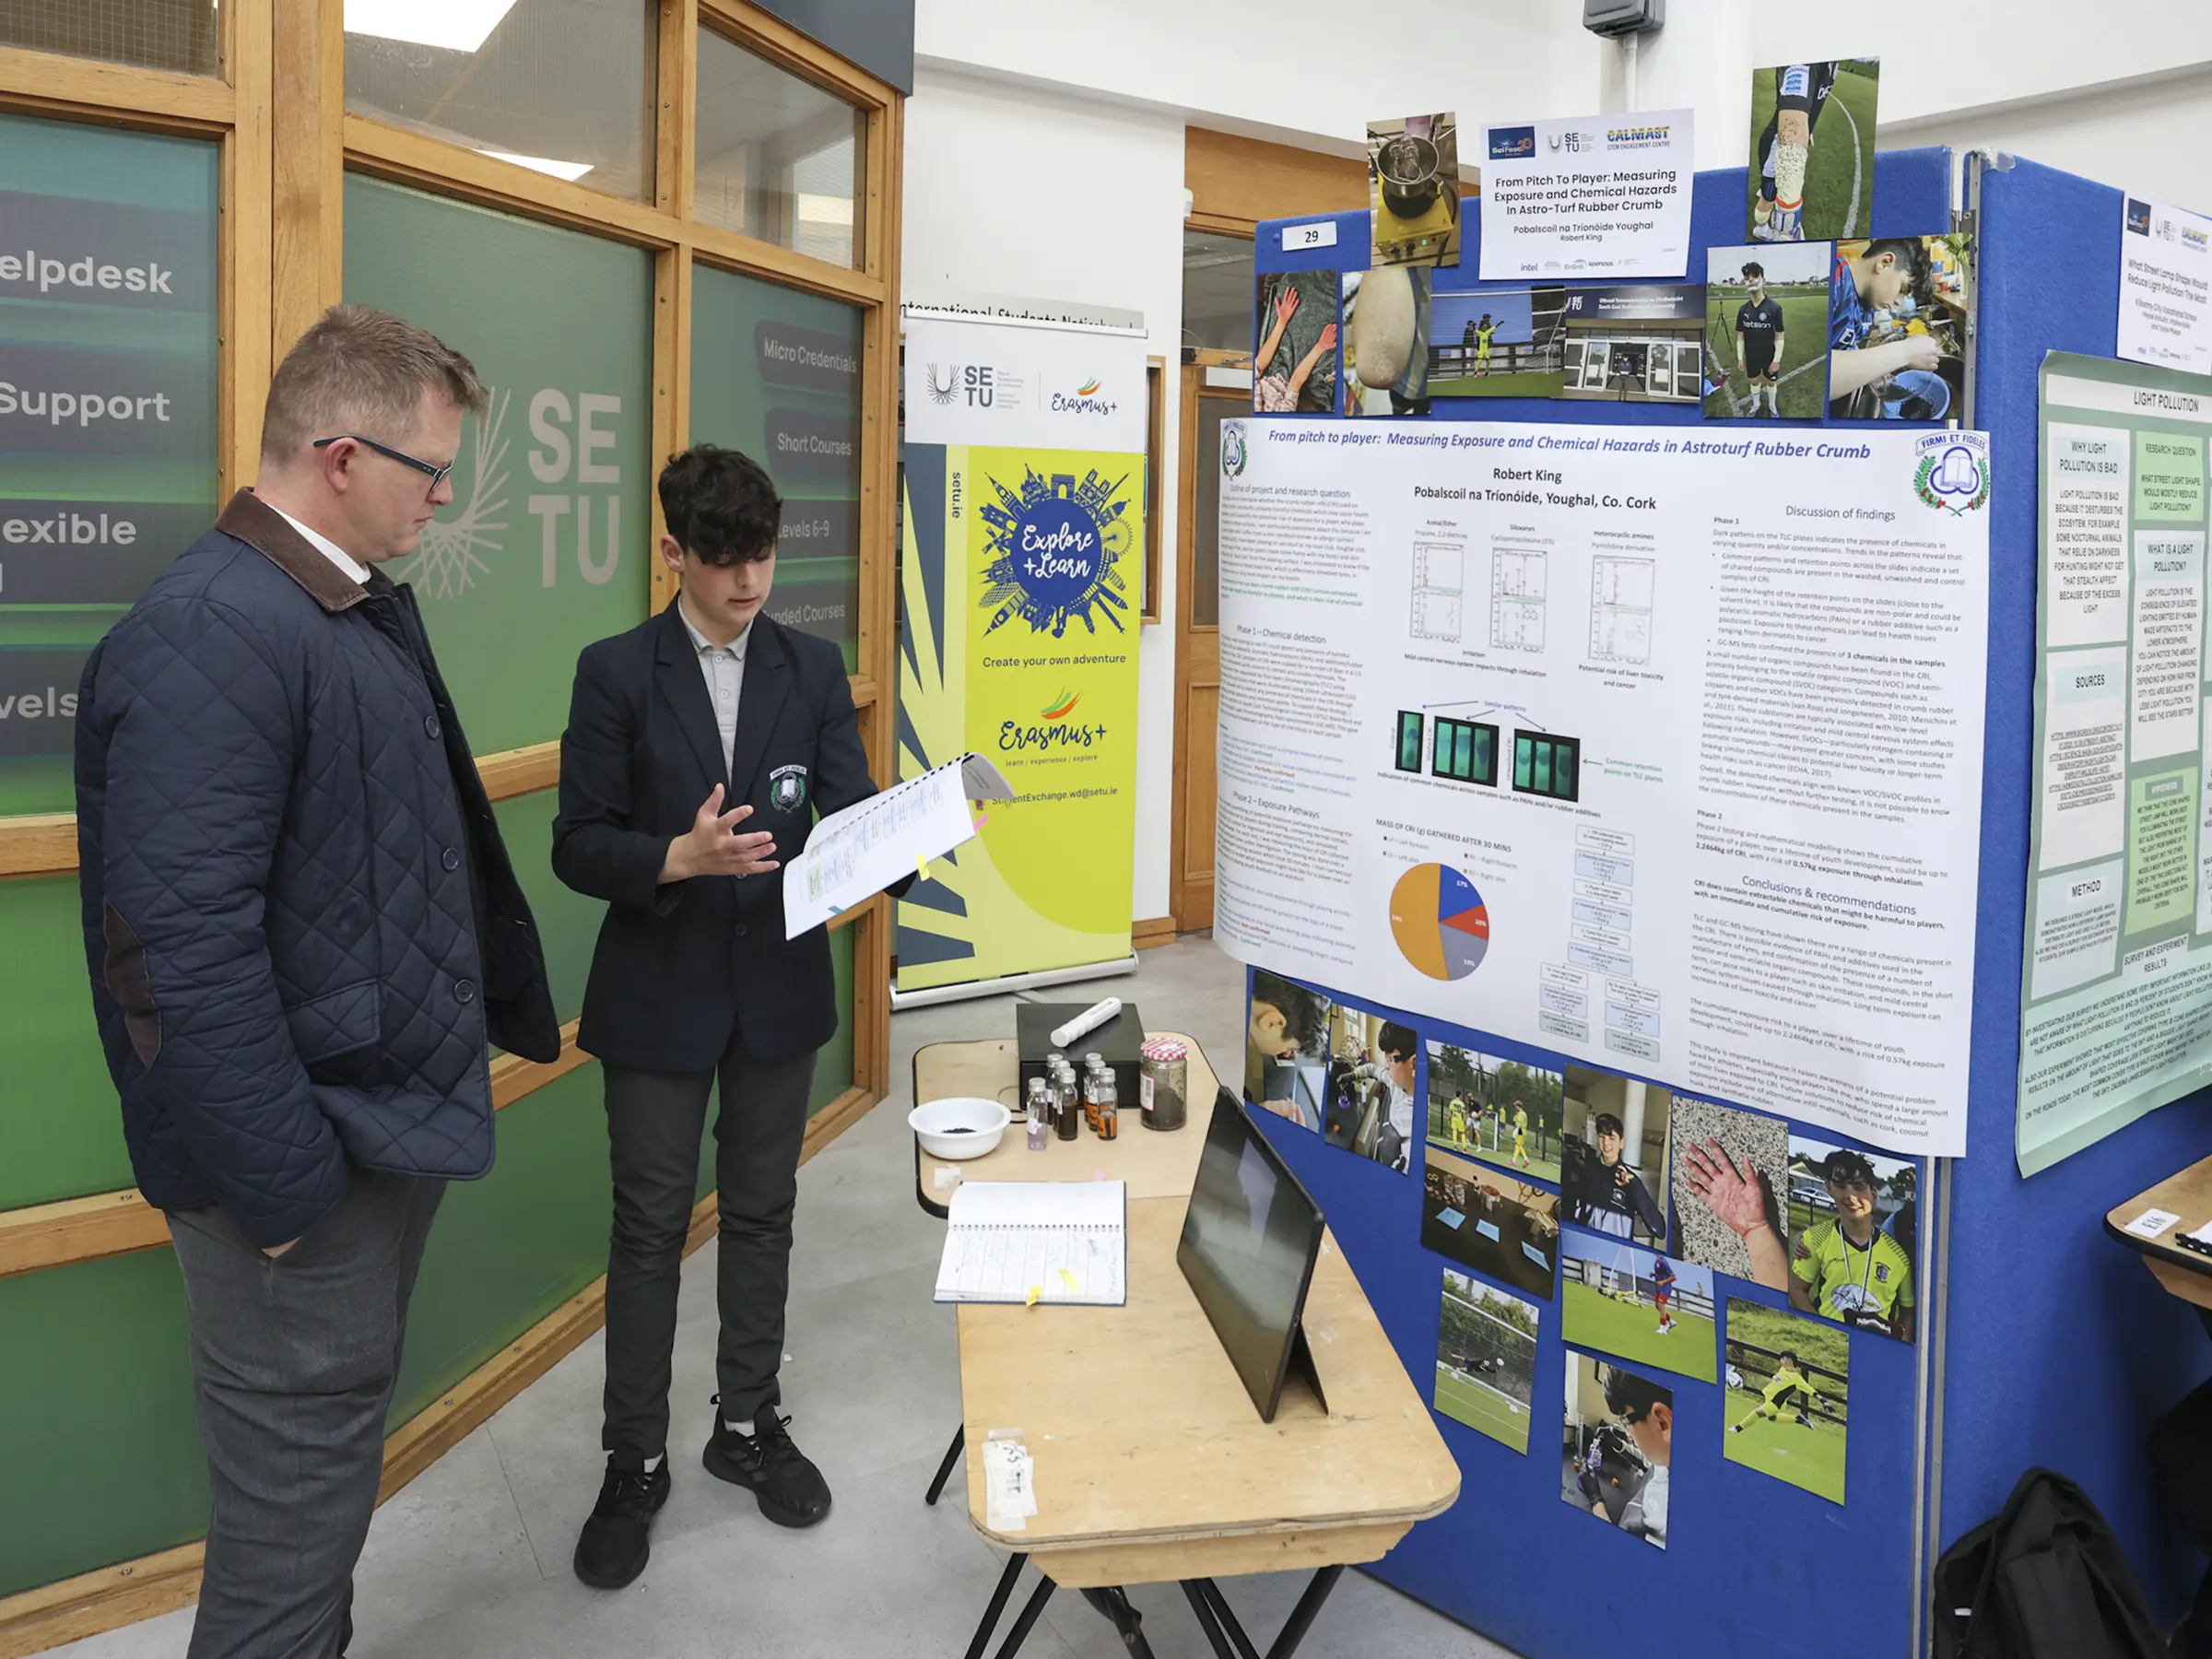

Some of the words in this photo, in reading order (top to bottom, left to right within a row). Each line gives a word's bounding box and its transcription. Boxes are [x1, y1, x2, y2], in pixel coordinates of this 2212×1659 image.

[1565, 133, 1579, 142] SE
[1607, 127, 1670, 142] CALMAST
[1565, 143, 1579, 152] TU
[1620, 142, 1653, 150] ENGAGEMENT
[1496, 178, 1524, 188] From
[1526, 175, 1553, 186] Pitch
[1556, 175, 1570, 185] To
[1572, 173, 1610, 186] Player:
[1613, 170, 1677, 182] Measuring
[1494, 191, 1544, 204] Exposure
[1547, 189, 1568, 200] and
[1571, 186, 1626, 199] Chemical
[1629, 184, 1677, 196] Hazards
[1506, 206, 1517, 216] In
[1519, 203, 1576, 216] Astro-Turf
[1578, 201, 1618, 212] Rubber
[1621, 200, 1663, 212] Crumb
[1305, 229, 1319, 243] 29
[1513, 224, 1558, 235] Pobalscoil
[1616, 221, 1653, 232] Youghal
[1586, 234, 1603, 243] King
[0, 250, 173, 294] elpdesk
[1521, 263, 1538, 272] intel
[764, 337, 796, 362] Micro
[798, 347, 857, 373] Credentials
[964, 365, 993, 386] SE
[0, 382, 171, 427] Support
[965, 387, 993, 407] TU
[1052, 393, 1118, 415] Erasmus+
[2135, 391, 2157, 407] LIGHT
[2159, 394, 2199, 413] POLLUTION
[527, 388, 621, 483] SE
[778, 432, 808, 453] Short
[810, 436, 852, 455] Courses
[1269, 430, 1296, 442] From
[1299, 431, 1325, 444] pitch
[1328, 433, 1339, 442] to
[1342, 432, 1381, 446] player:
[1387, 433, 1448, 449] Measuring
[1451, 434, 1505, 450] Exposure
[1509, 436, 1533, 449] and
[1537, 436, 1600, 450] Chemical
[1603, 439, 1660, 453] Hazards
[1664, 440, 1677, 453] in
[1681, 441, 1752, 457] Astroturf
[1754, 442, 1812, 457] Rubber
[1816, 443, 1871, 459] Crumb
[1922, 435, 1947, 450] FIRMI
[1950, 434, 1959, 442] ET
[1962, 434, 1985, 451] FIDELES
[2071, 441, 2087, 453] WHY
[2088, 442, 2107, 454] LIGHT
[2146, 443, 2171, 454] RESEARCH
[2171, 445, 2196, 457] QUESTION
[2060, 459, 2096, 473] POLLUTION
[2097, 463, 2103, 472] IS
[2104, 462, 2118, 474] BAD
[1493, 468, 1532, 481] Robert
[1535, 469, 1562, 484] King
[952, 472, 963, 519] setu.ie
[1414, 486, 1466, 500] Pobalscoil
[1469, 490, 1482, 500] na
[1485, 488, 1543, 505] Tríonóide,
[1547, 492, 1599, 508] Youghal,
[1602, 495, 1622, 508] Co.
[1627, 496, 1656, 509] Cork
[1786, 505, 1840, 519] Discussion
[1842, 510, 1854, 519] of
[1855, 509, 1896, 522] findings
[3, 512, 136, 545] exible
[813, 520, 830, 537] 6-9
[1021, 522, 1094, 553] Explore
[527, 495, 620, 588] TU
[1023, 552, 1091, 579] +Learn
[804, 604, 845, 624] Courses
[982, 657, 1020, 667] Create
[1023, 658, 1046, 668] your
[1049, 656, 1070, 665] own
[1073, 654, 1126, 665] adventure
[1900, 656, 1912, 665] the
[2076, 674, 2105, 688] SOURCES
[999, 721, 1107, 750] Erasmus+
[1030, 756, 1066, 766] experience
[1073, 754, 1098, 763] explore
[992, 787, 1118, 805] StentExchange.wd@setu.ie
[1376, 819, 1394, 830] MASS
[1405, 824, 1416, 833] CRI
[1417, 827, 1425, 836] (g)
[1427, 829, 1460, 842] GATHERED
[1462, 835, 1482, 846] AFTER
[1483, 840, 1493, 848] 30
[1493, 841, 1512, 853] MINS
[1818, 865, 1851, 877] exposure
[1853, 870, 1882, 882] through
[1742, 876, 1803, 898] Conclusions
[1805, 888, 1814, 899] &
[1816, 890, 1916, 915] recommendations
[2072, 879, 2101, 897] METHOD
[2156, 936, 2188, 956] EXPERIMENT
